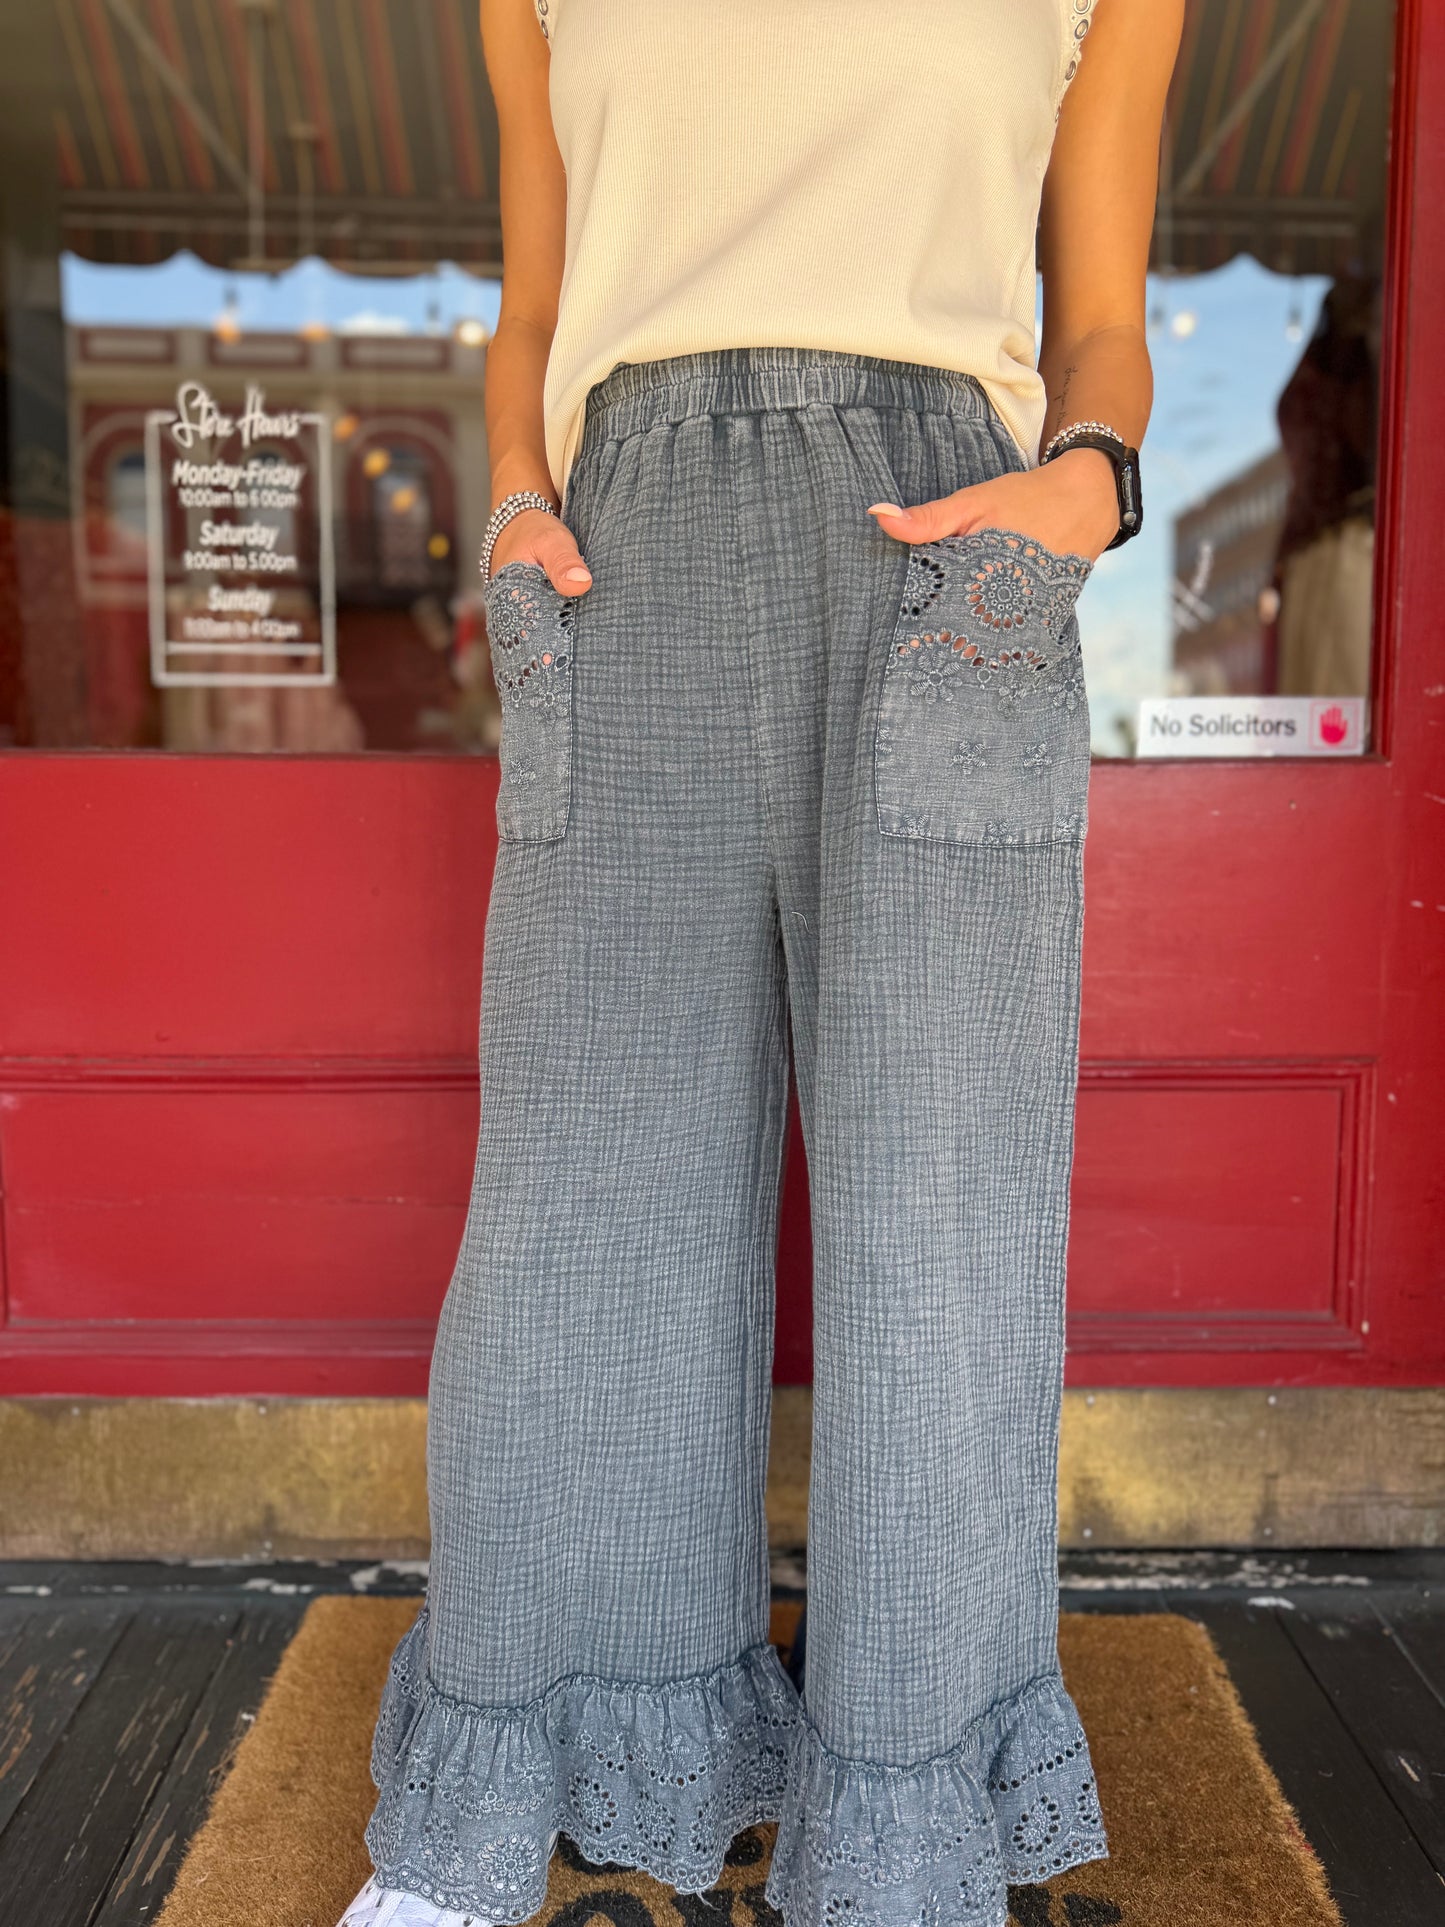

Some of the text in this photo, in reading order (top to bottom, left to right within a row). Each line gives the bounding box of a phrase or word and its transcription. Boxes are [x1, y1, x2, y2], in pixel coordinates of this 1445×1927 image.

[172, 378, 299, 448] Store Hours
[173, 459, 304, 490] Monday-Friday
[233, 489, 248, 508] to
[199, 519, 279, 550] Saturday
[233, 552, 247, 571] to
[207, 584, 272, 616] Sunday
[1150, 714, 1296, 737] No Solicitors
